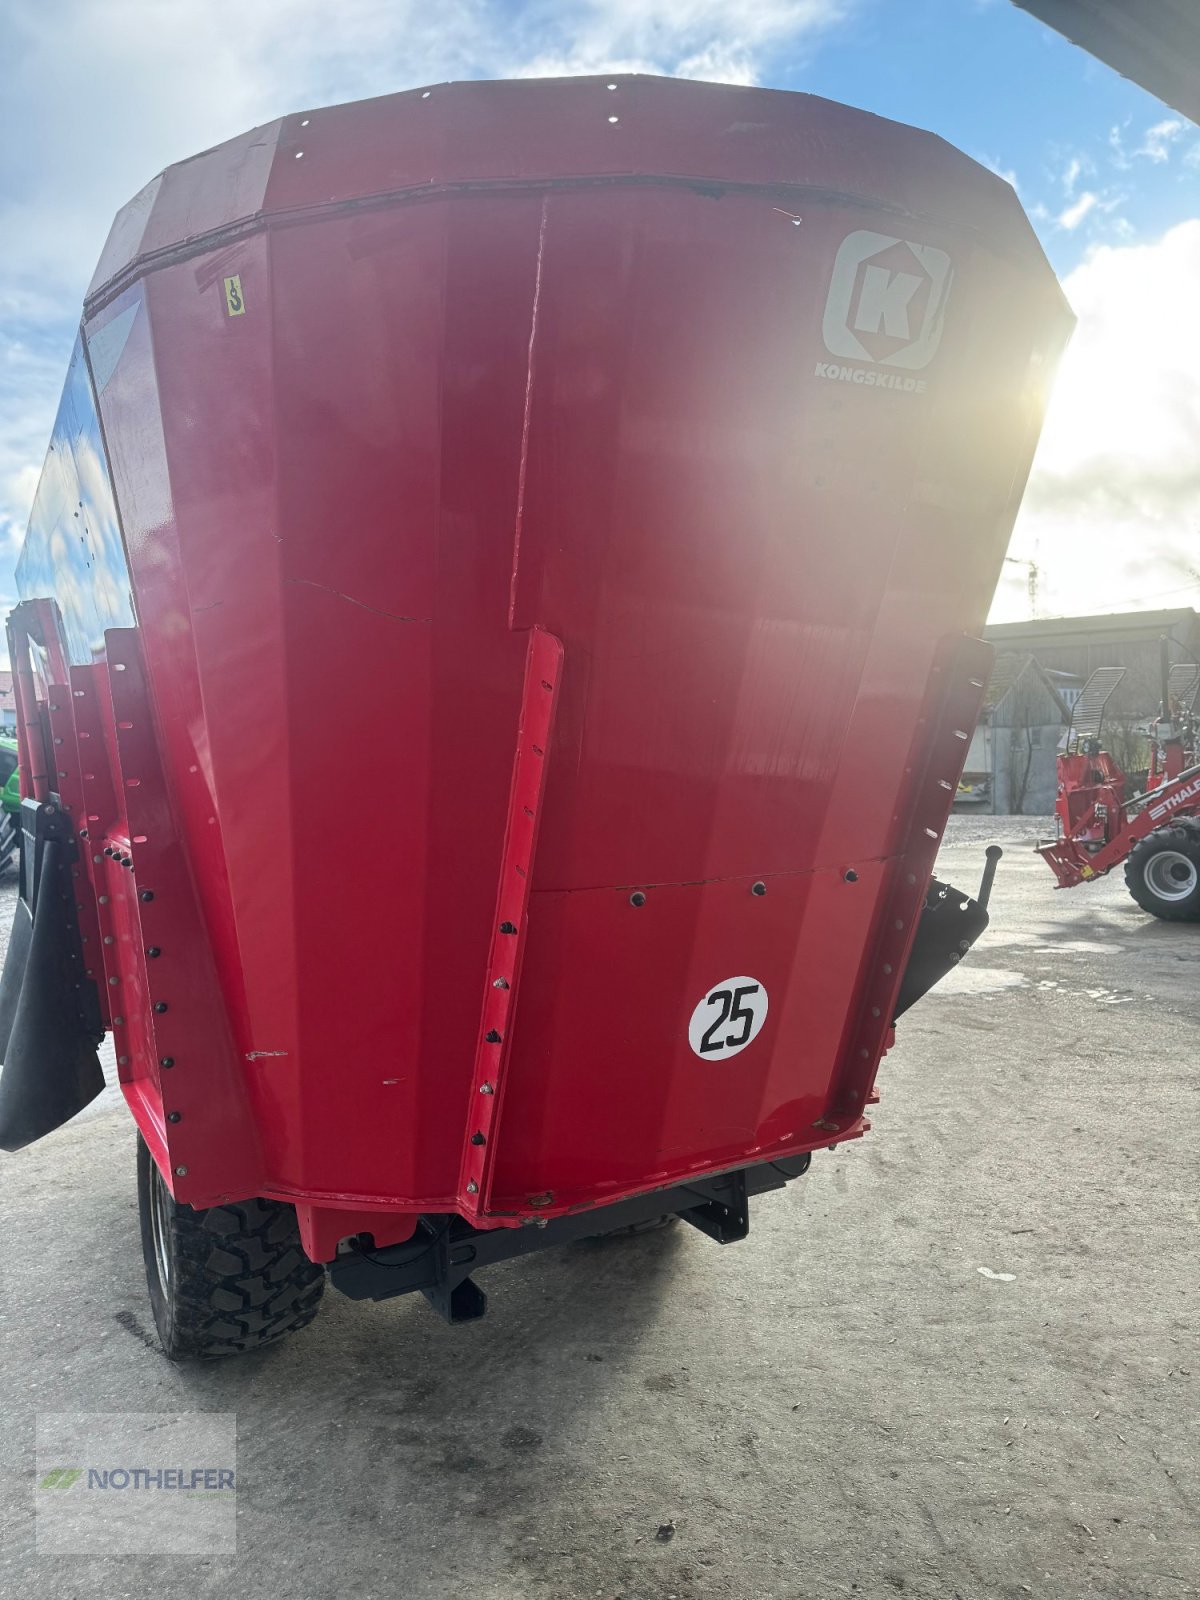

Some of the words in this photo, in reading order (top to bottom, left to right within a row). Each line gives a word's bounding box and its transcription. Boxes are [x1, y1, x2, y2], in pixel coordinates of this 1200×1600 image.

[854, 264, 924, 340] K
[814, 361, 928, 394] KONGSKILDE
[699, 984, 759, 1053] 25
